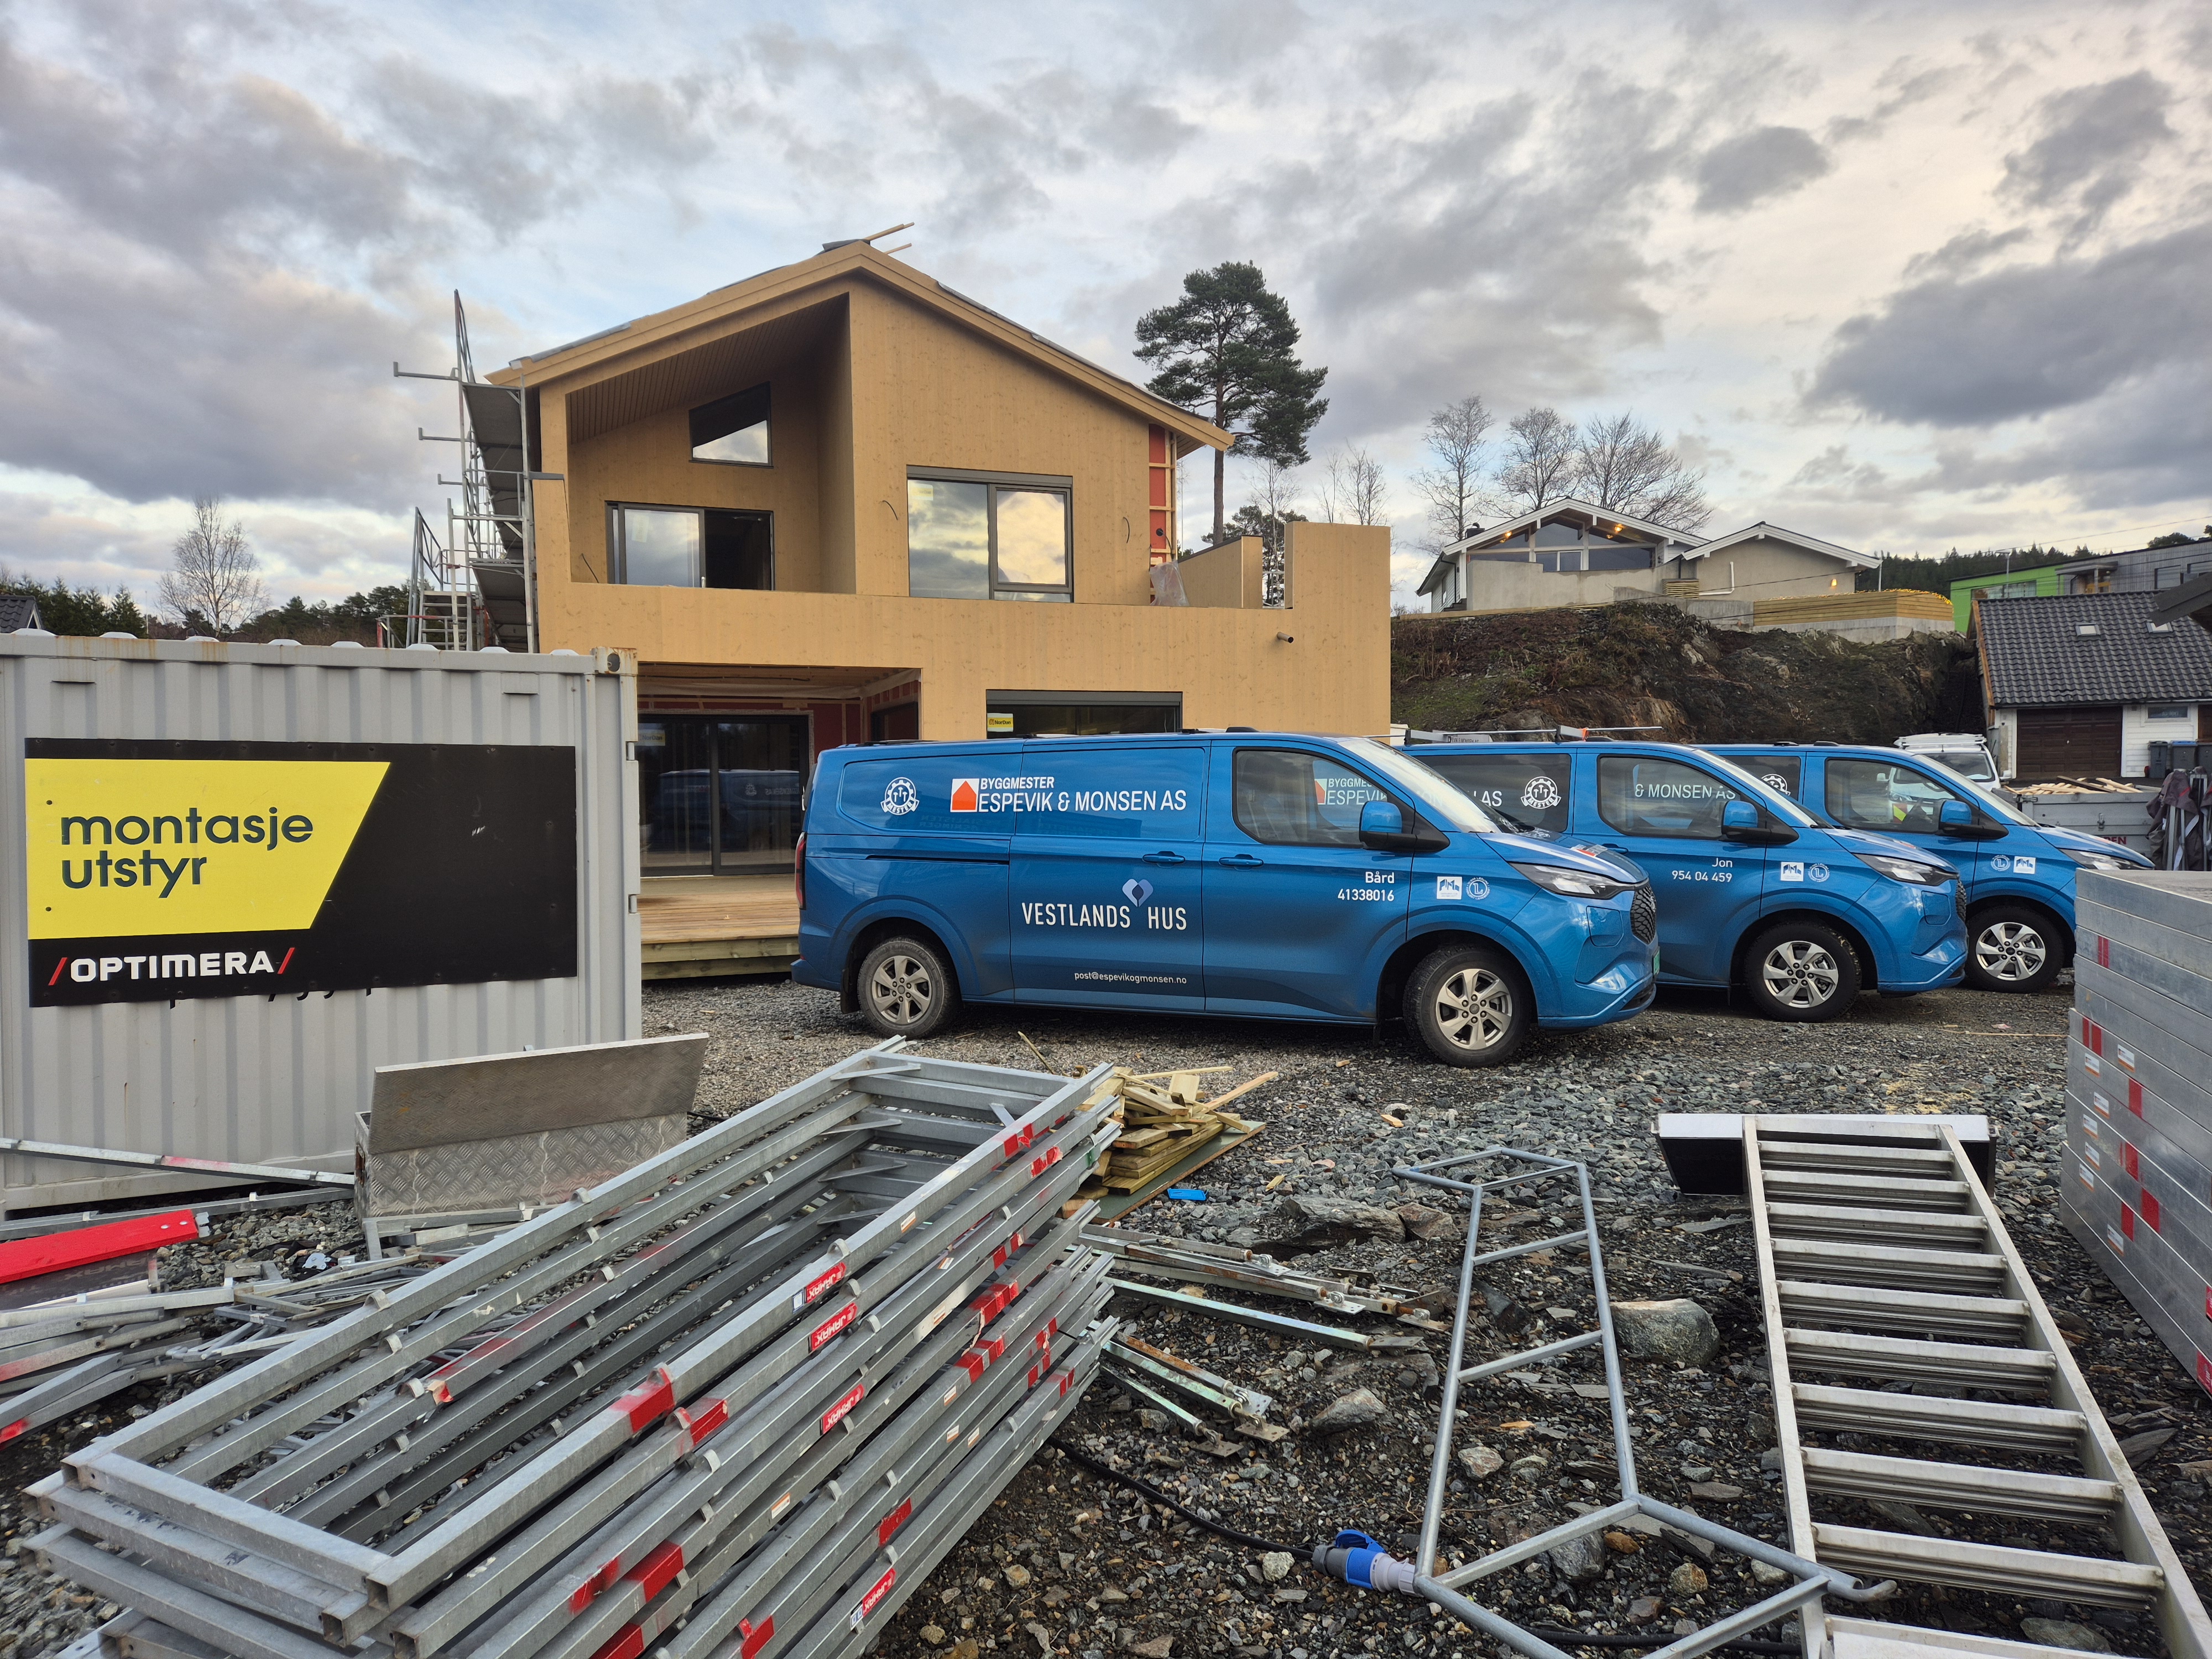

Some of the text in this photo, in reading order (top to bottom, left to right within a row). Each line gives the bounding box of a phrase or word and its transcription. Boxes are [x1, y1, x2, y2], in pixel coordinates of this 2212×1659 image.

[980, 777, 1054, 790] BYGGMESTER
[1635, 784, 1644, 797] &
[1648, 784, 1712, 799] MONSEN
[979, 790, 1186, 812] ESPEVIK & MONSEN AS
[1527, 796, 1554, 808] MESTER
[886, 802, 913, 814] MESTER
[61, 807, 314, 851] montasje
[1712, 858, 1733, 868] Jon
[62, 850, 207, 899] utstyr
[1365, 872, 1395, 884] Bård
[1672, 870, 1733, 883] 954 04 459
[1338, 889, 1395, 901] 41338016
[1022, 903, 1187, 930] VESTLANDS HUS
[1074, 972, 1187, 984] post@espevikogmonsen.no
